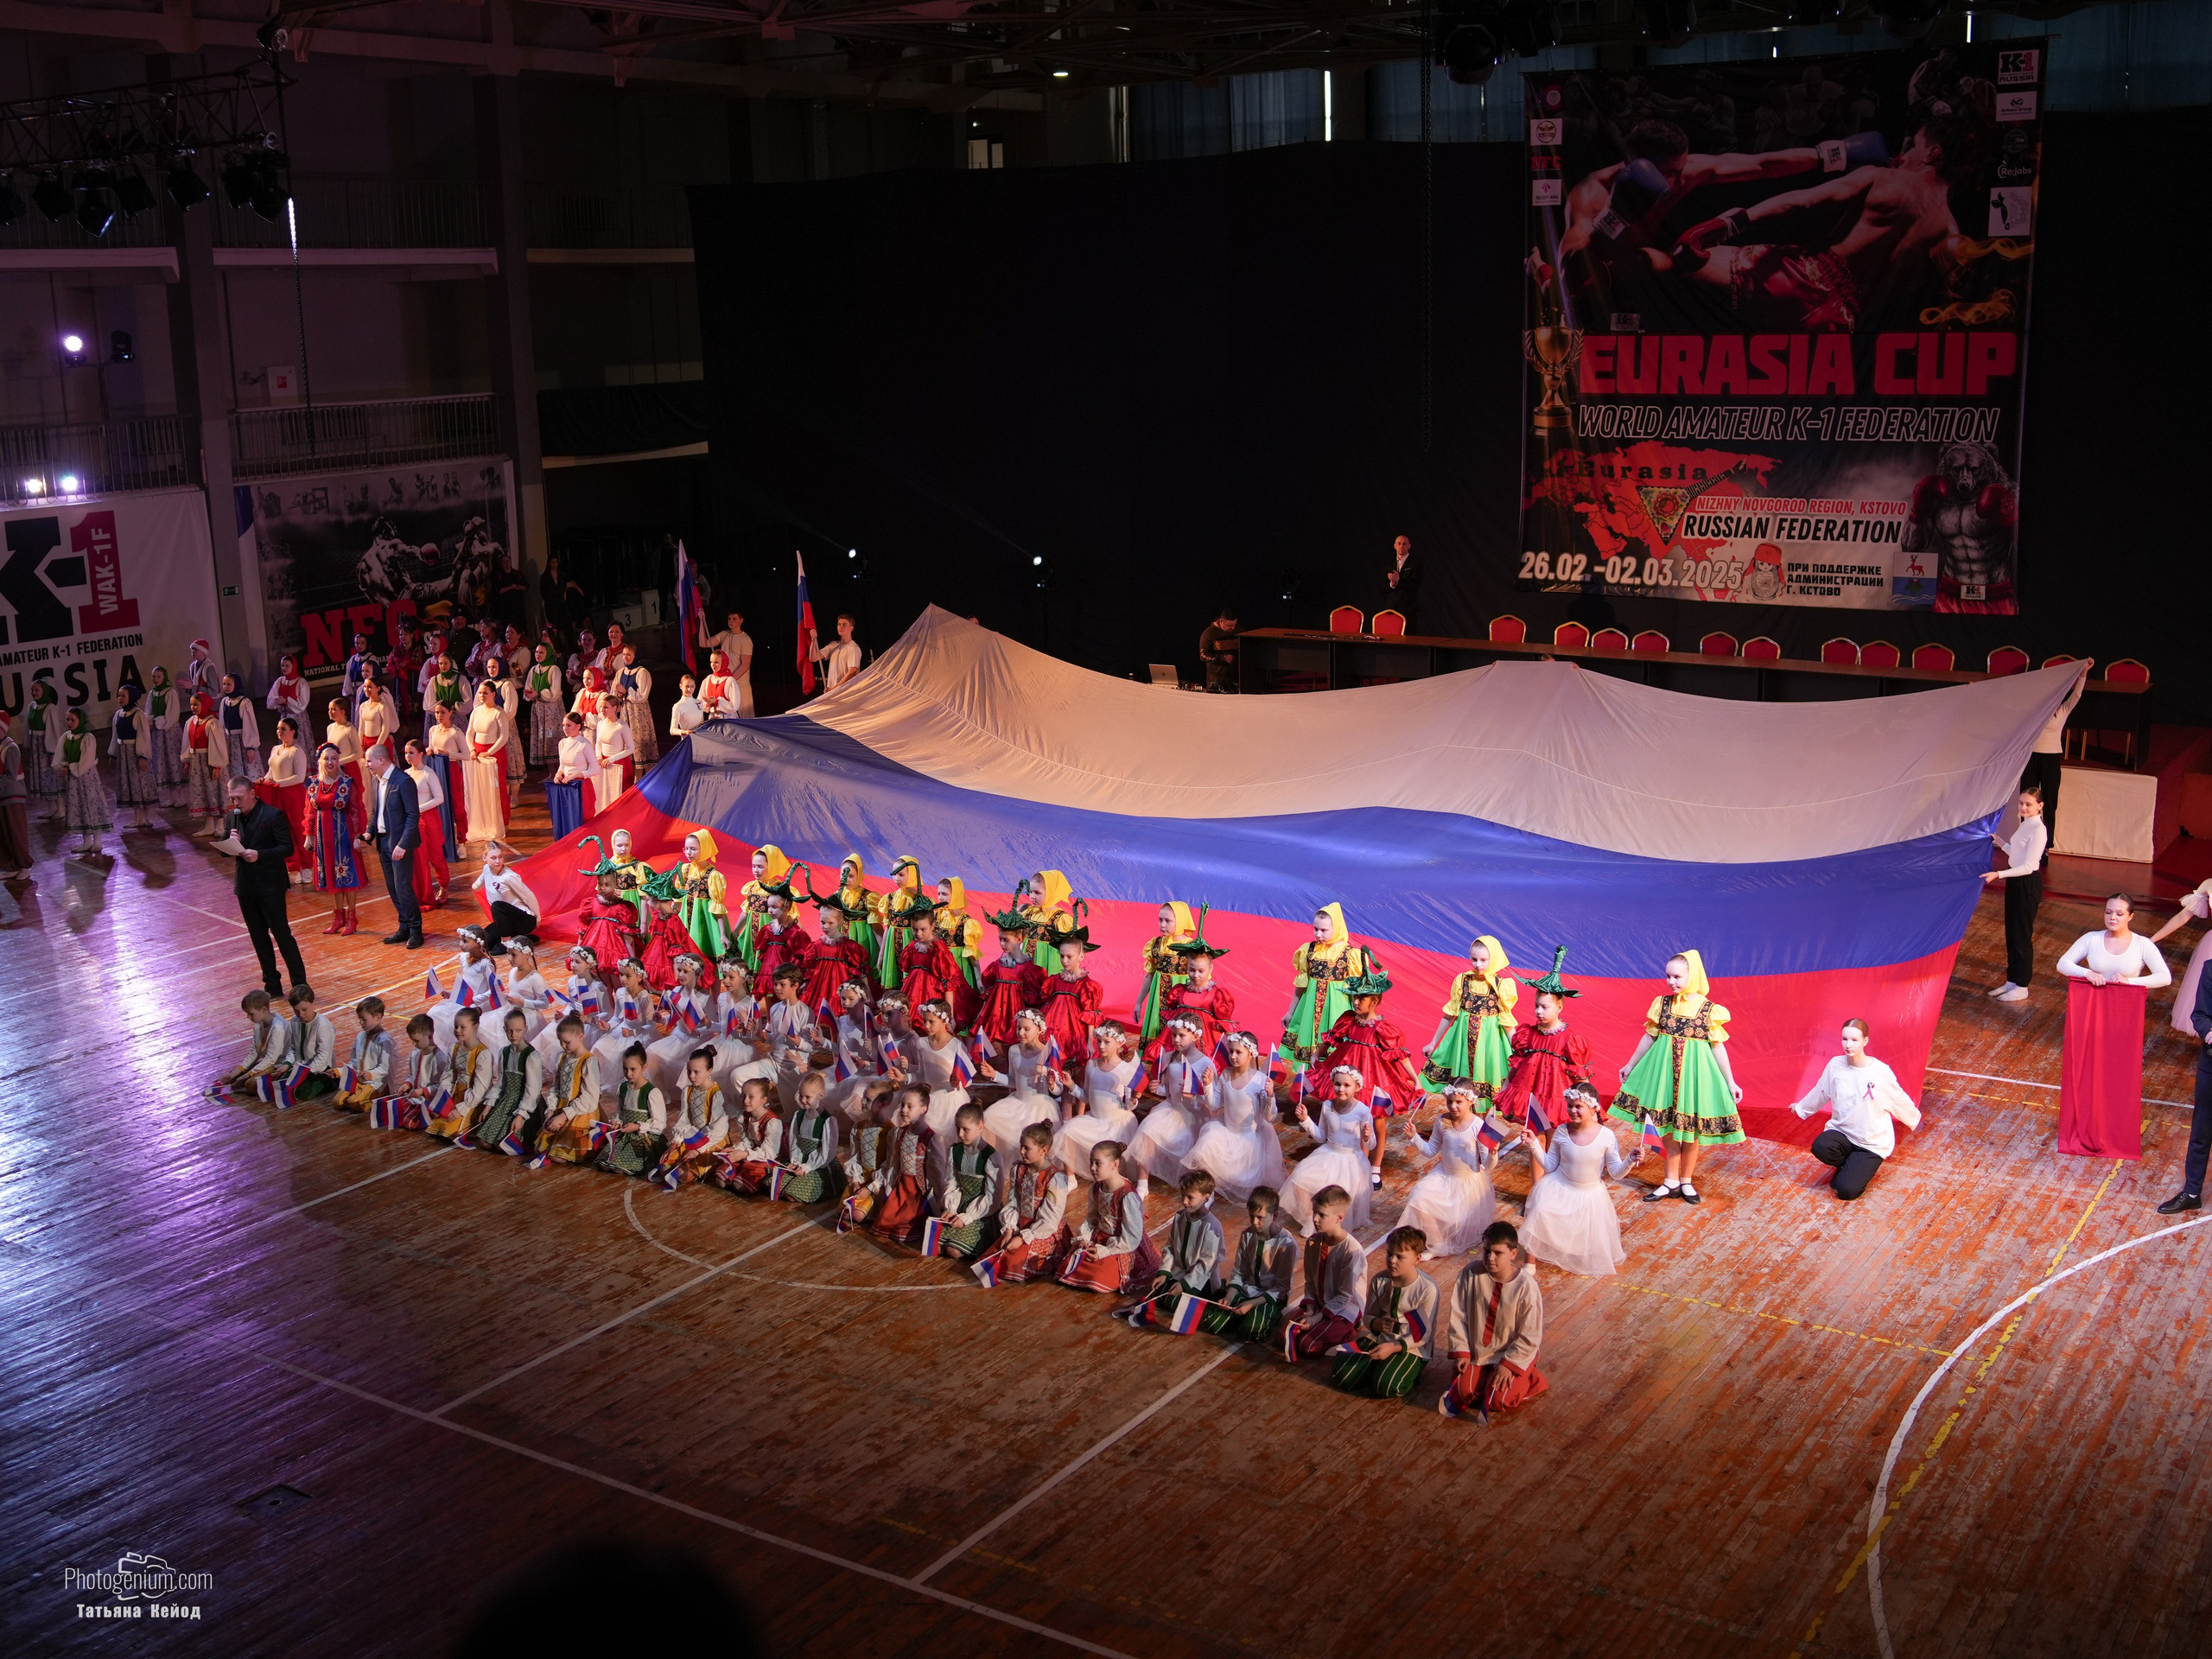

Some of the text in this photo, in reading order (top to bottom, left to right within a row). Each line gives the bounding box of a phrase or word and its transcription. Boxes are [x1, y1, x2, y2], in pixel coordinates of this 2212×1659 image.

[2000, 52, 2034, 73] K-1
[1999, 74, 2034, 83] RUSSIA
[1530, 156, 1561, 169] NFC
[1999, 166, 2032, 177] Re:jobs
[1580, 332, 2017, 396] EURASIA CUP
[1578, 404, 2000, 442] WORLD AMATEUR K-1 FEDERATION
[1581, 460, 1707, 480] Eurasia
[1696, 496, 1906, 517] NIZHNY NOVGOROD REGION, KSTOVO
[1684, 515, 1902, 543] RUSSIAN FEDERATION
[91, 528, 118, 615] WAK-1F
[1518, 551, 1587, 582] 26.02
[1787, 563, 1882, 575] ПРИ ПОДДЕРЖКЕ
[0, 510, 140, 644] K-1
[1787, 574, 1884, 588] АДМИНИСТРАЦИИ
[1786, 585, 1841, 596] Г. КСТОВО
[652, 601, 657, 613] 1
[625, 613, 632, 626] 3
[53, 645, 71, 658] K-1
[77, 633, 143, 655] FEDERATION
[304, 664, 340, 677] NATIONAL
[0, 655, 146, 718] USSIA
